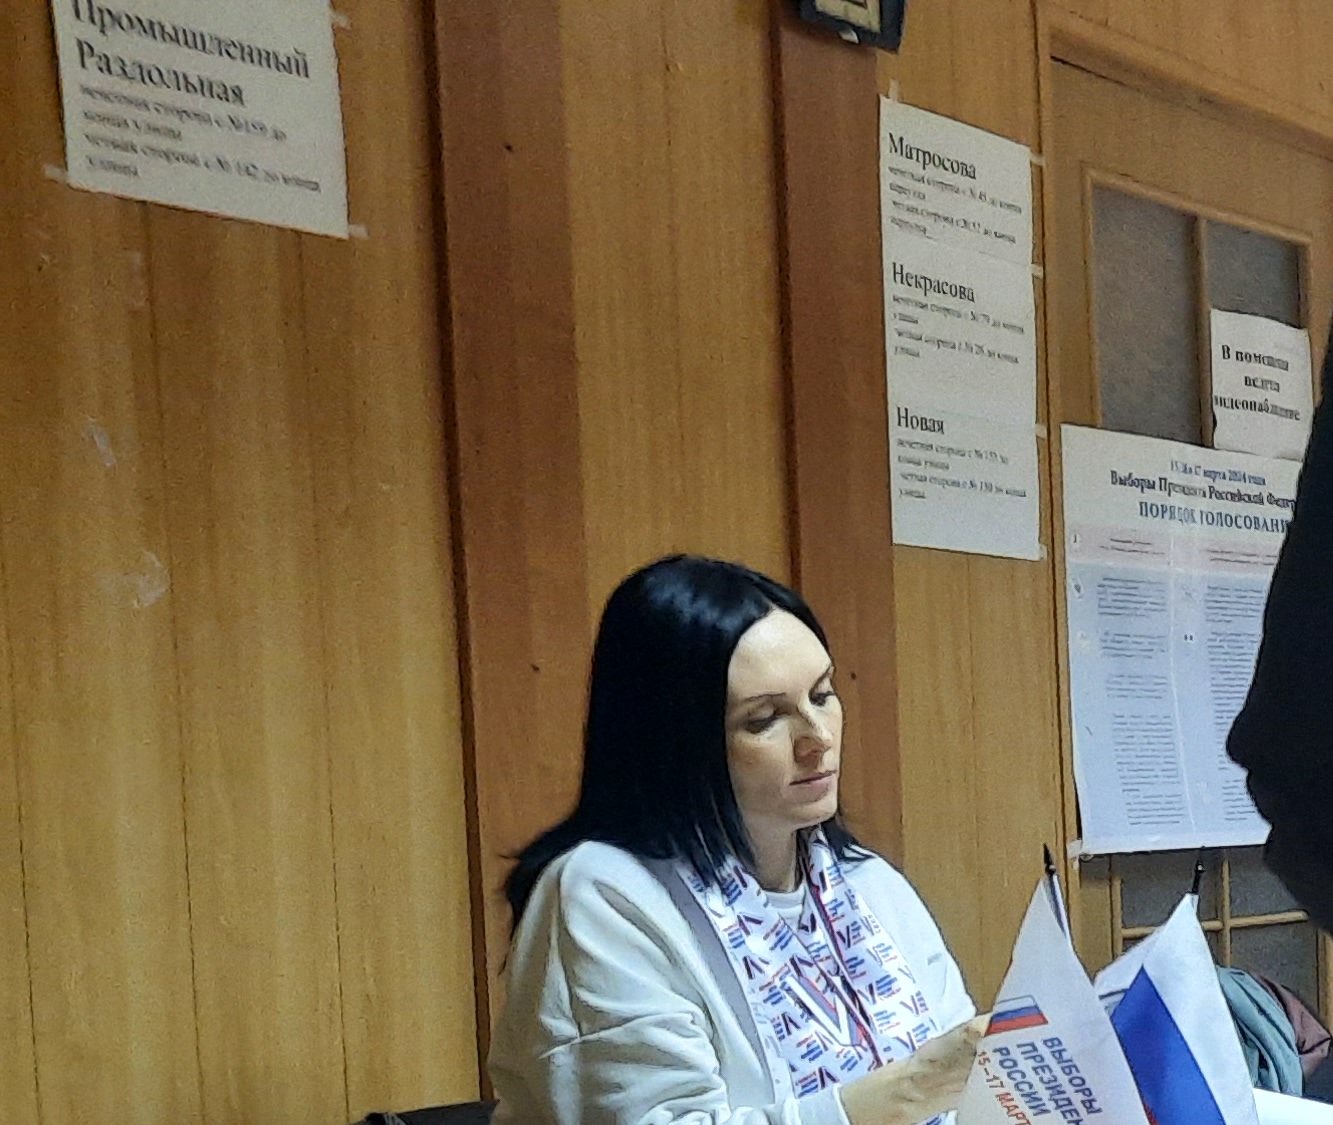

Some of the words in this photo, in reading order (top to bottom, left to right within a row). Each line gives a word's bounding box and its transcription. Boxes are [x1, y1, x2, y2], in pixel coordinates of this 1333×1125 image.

[72, 0, 310, 78] Промышленный
[75, 36, 247, 107] Раздольная
[888, 132, 977, 180] Матросова
[892, 261, 976, 303] Некрасова
[1221, 344, 1231, 360] В
[896, 406, 945, 435] Новая
[1110, 469, 1156, 494] Выборы
[1138, 501, 1197, 525] ПОРЯДОК
[992, 1046, 1051, 1117] РОССИИ
[1042, 1036, 1103, 1115] ВЫБОРЫ
